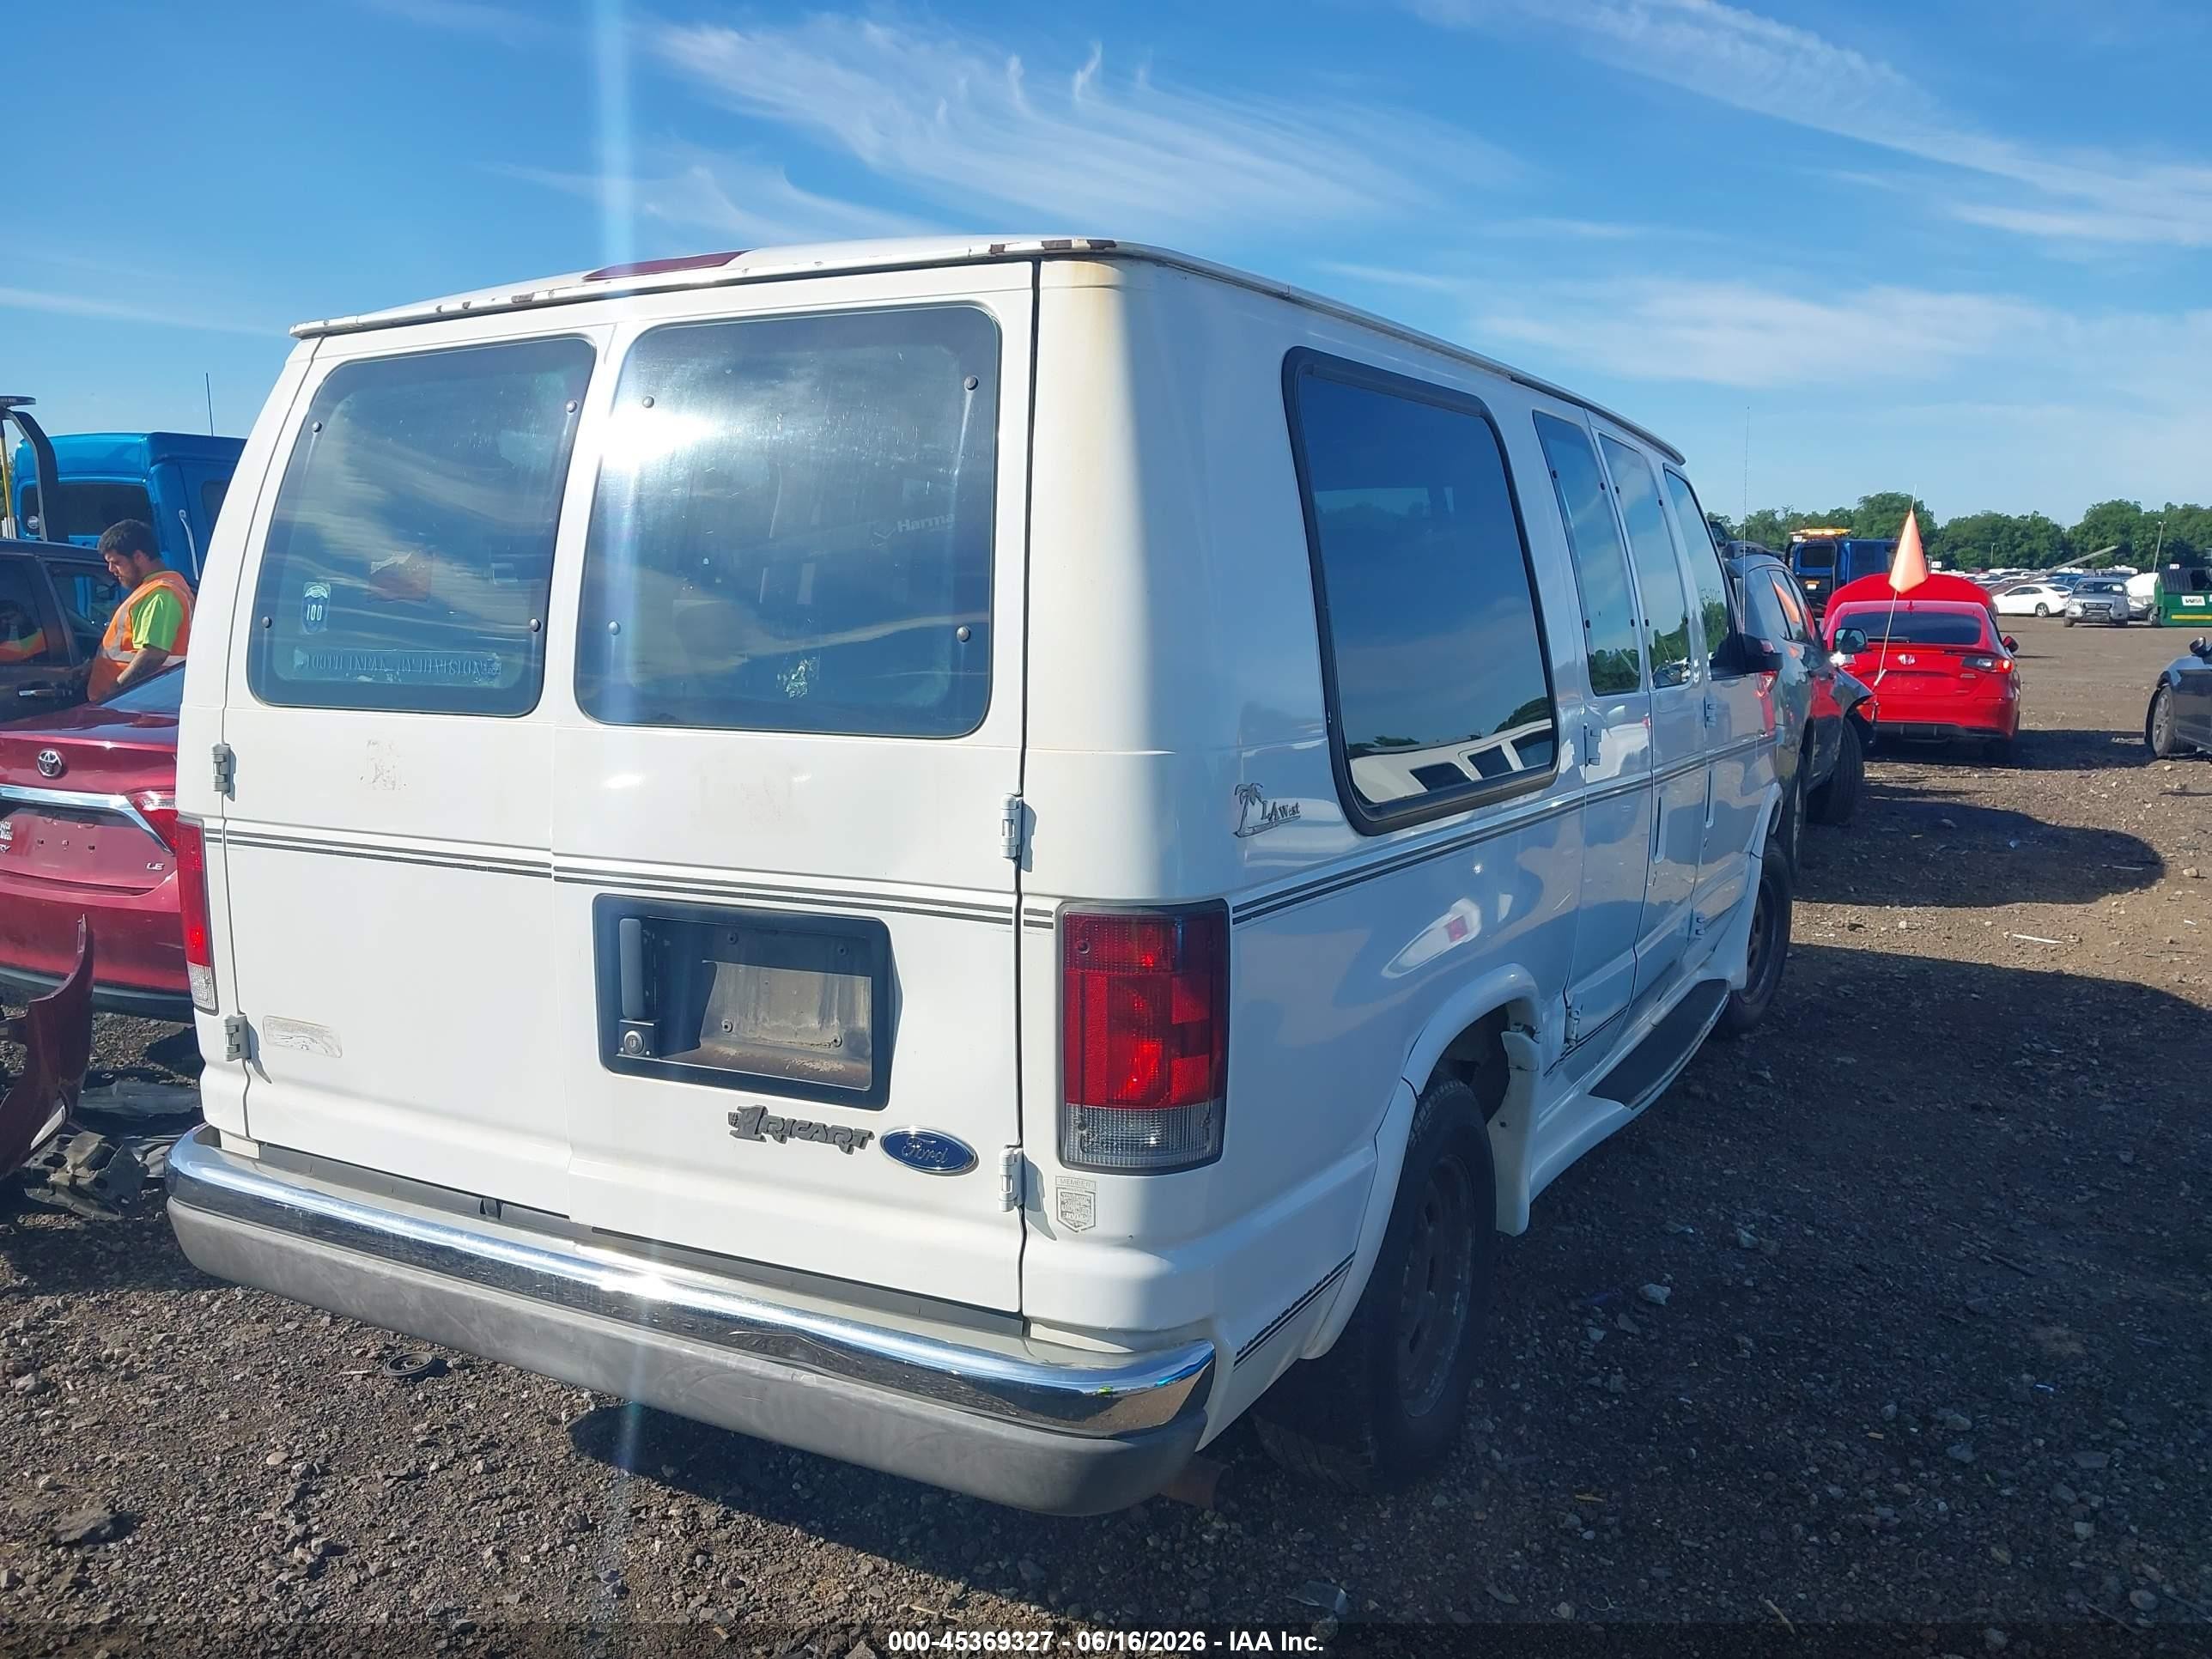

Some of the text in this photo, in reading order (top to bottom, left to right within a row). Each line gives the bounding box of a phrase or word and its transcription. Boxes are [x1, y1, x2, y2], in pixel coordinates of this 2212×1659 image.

[307, 604, 323, 622] 100
[146, 862, 165, 871] LE
[901, 1135, 951, 1164] Ford
